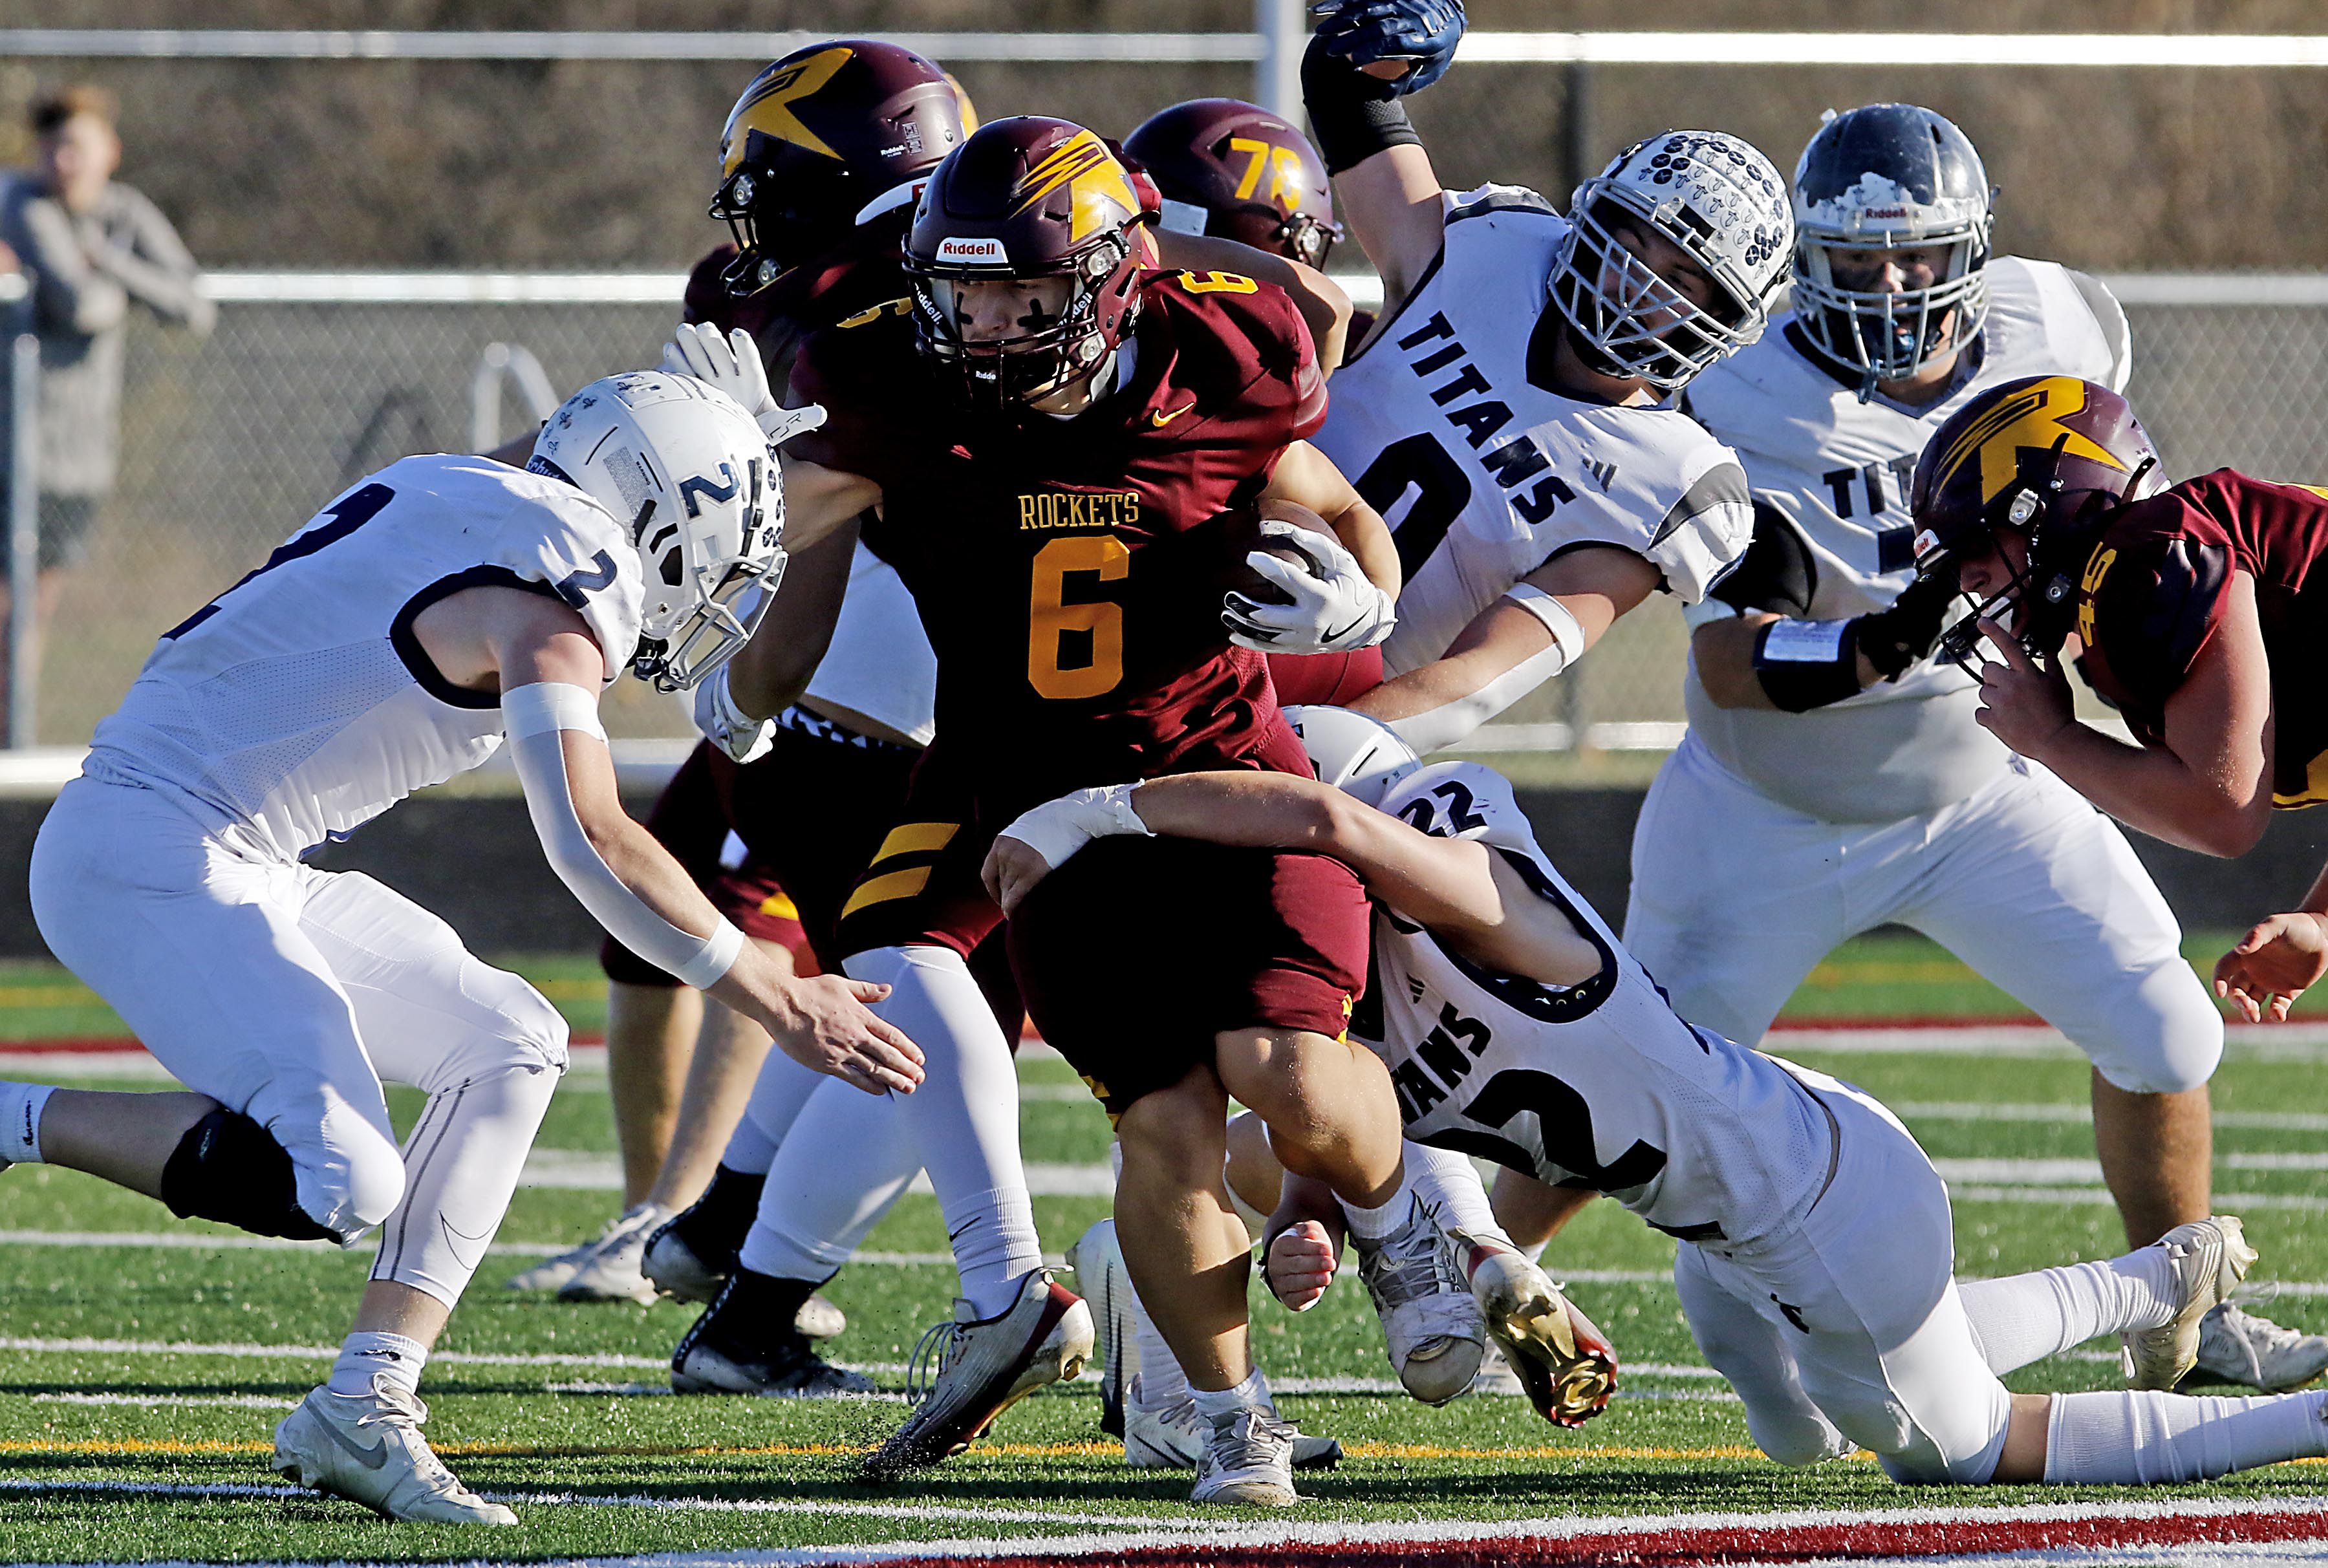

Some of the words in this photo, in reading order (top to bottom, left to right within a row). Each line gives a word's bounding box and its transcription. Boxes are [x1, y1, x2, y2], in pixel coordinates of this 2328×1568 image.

[943, 242, 996, 255] Riddell
[1178, 269, 1259, 294] 6
[1397, 310, 1577, 525] TITANS
[636, 460, 651, 486] WARNING
[679, 462, 740, 519] 2
[1822, 453, 1917, 520] TIT
[1018, 493, 1139, 530] ROCKETS
[555, 548, 617, 610] 2
[2078, 541, 2118, 647] 45
[1028, 535, 1130, 699] 6
[1397, 780, 1488, 838] 22
[1389, 1001, 1492, 1126] TANS
